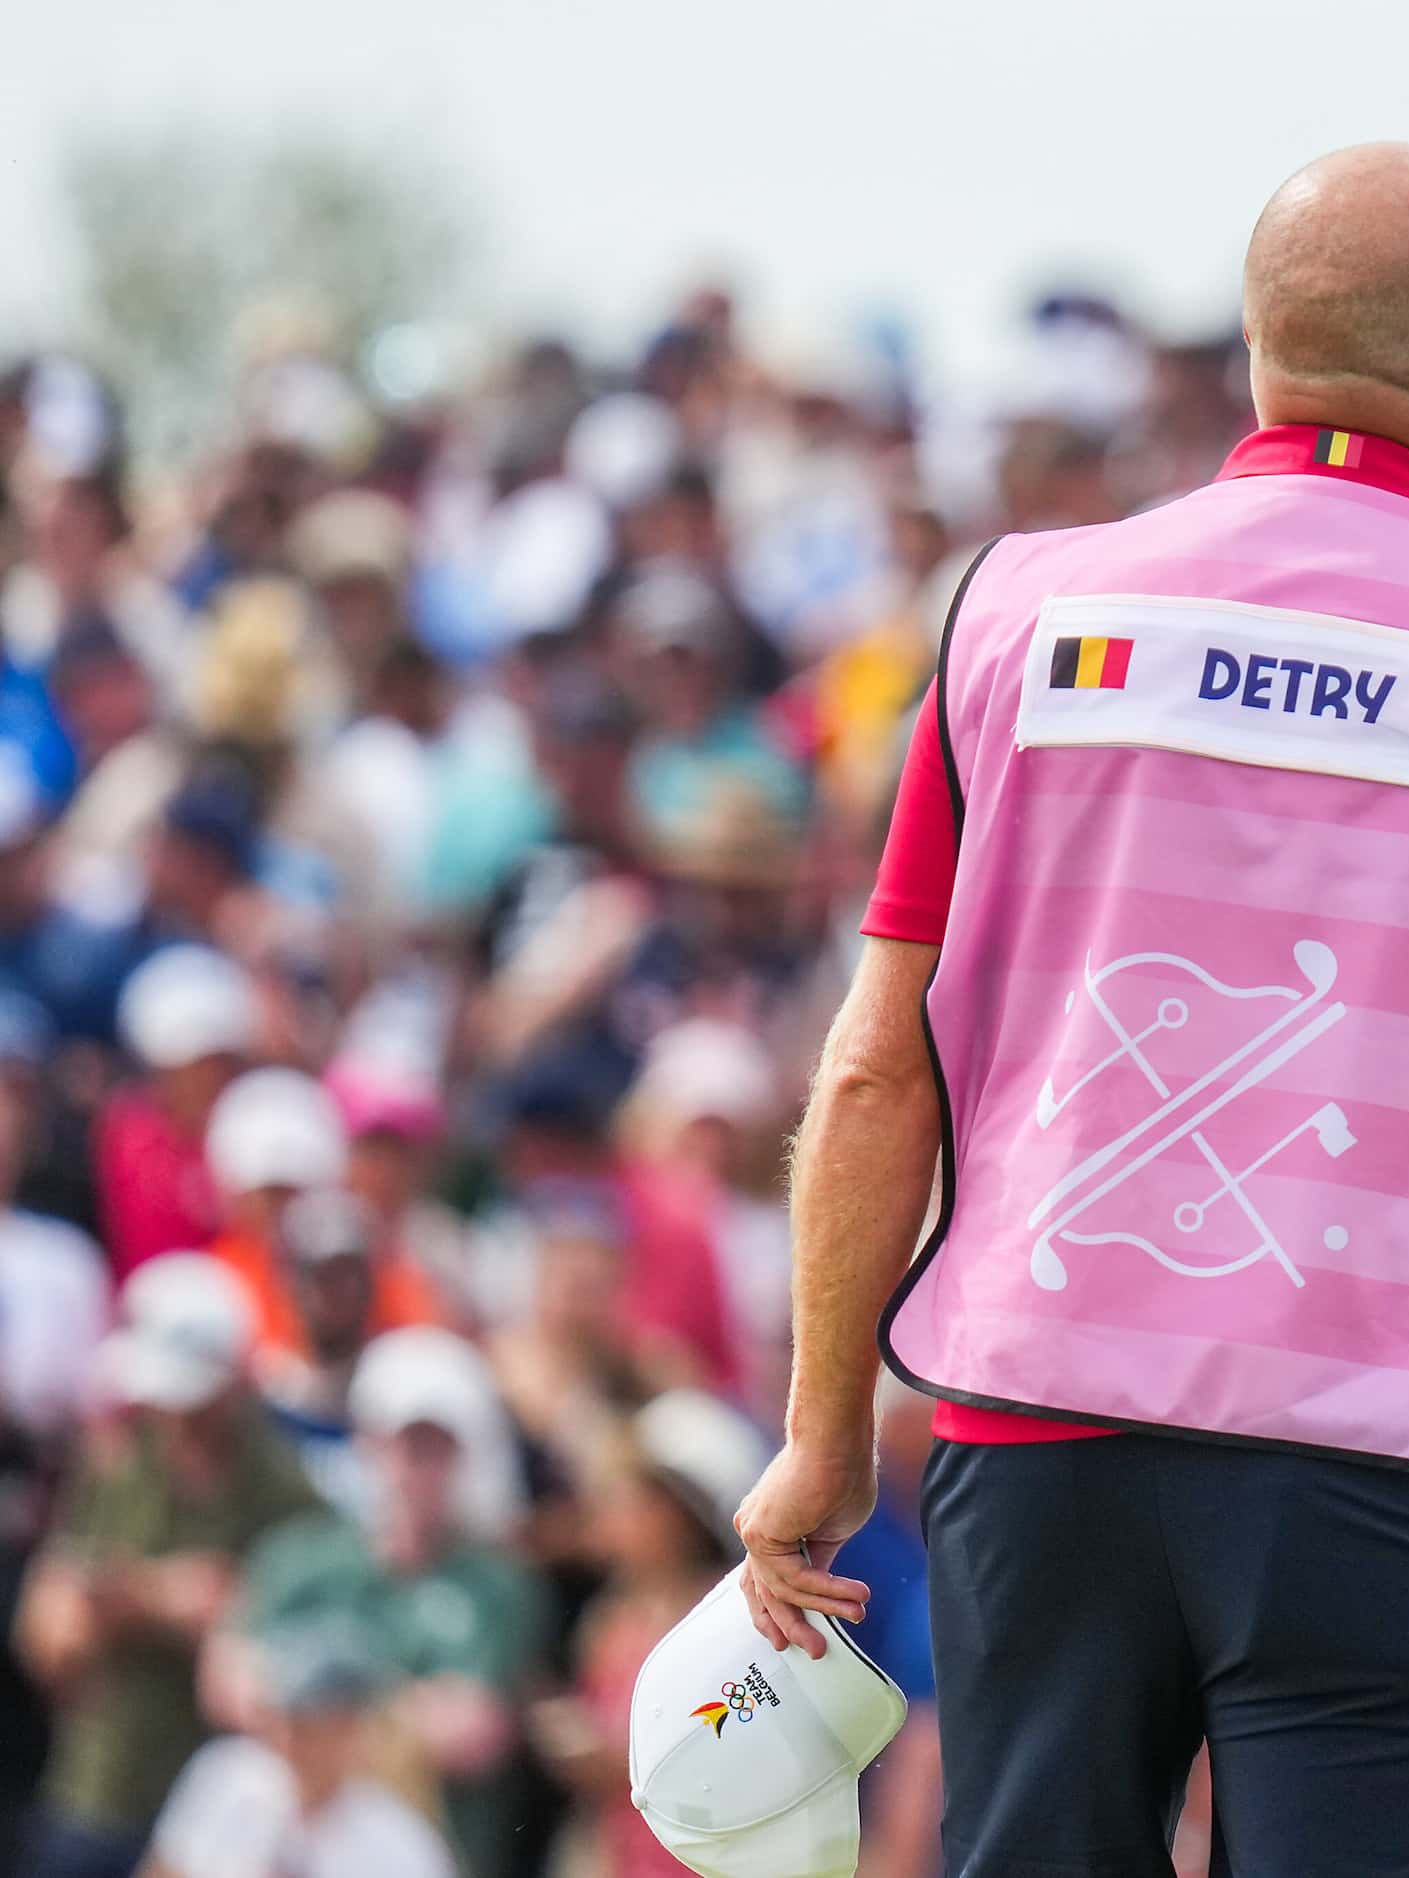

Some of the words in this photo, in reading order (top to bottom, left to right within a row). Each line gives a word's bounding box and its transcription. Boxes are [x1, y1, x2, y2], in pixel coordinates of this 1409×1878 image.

[1198, 647, 1398, 725] DETRY
[743, 1674, 767, 1707] TEAM
[748, 1662, 781, 1707] BELGIUM
